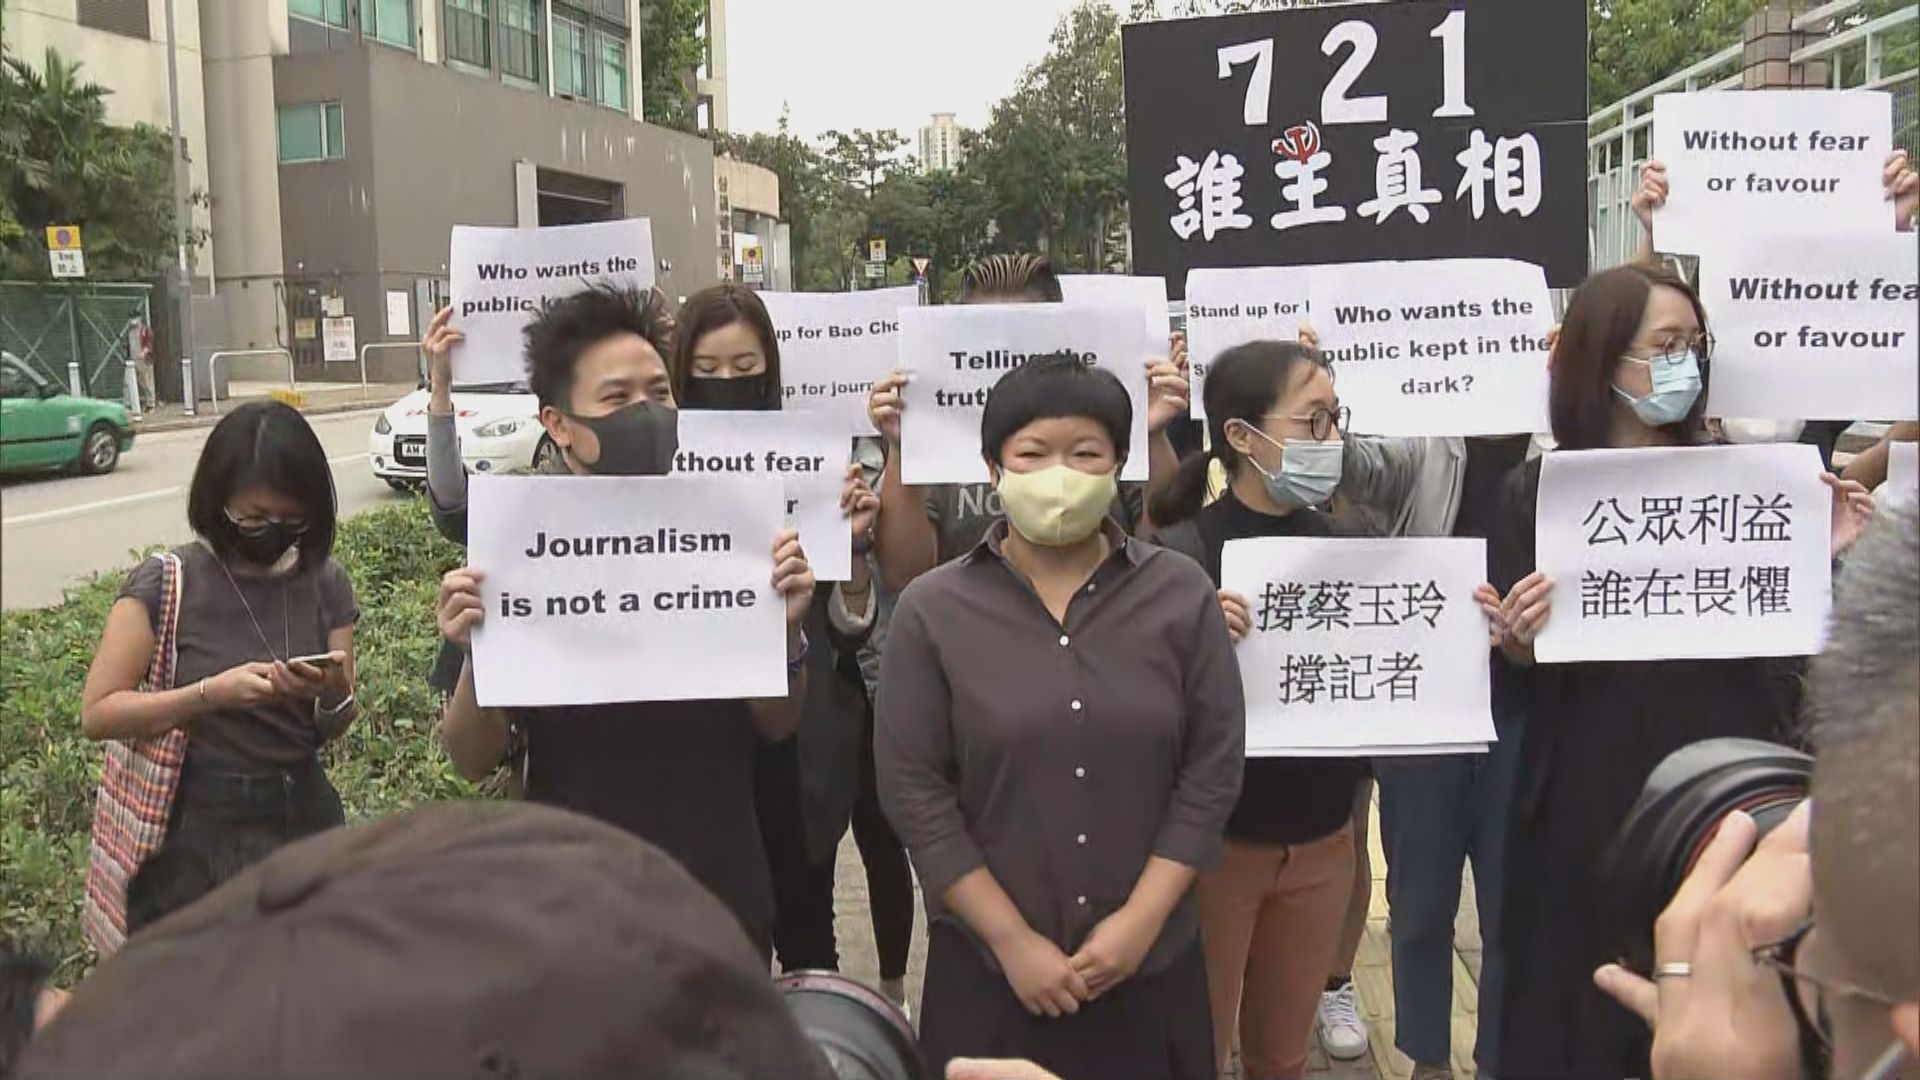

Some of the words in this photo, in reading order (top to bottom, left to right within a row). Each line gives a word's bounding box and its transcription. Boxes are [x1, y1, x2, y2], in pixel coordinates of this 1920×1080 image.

[1683, 129, 1798, 151] Without
[1808, 130, 1869, 151] fear
[1707, 177, 1736, 192] or
[1746, 173, 1840, 192] favour
[477, 263, 528, 281] Who
[536, 258, 601, 279] wants
[606, 255, 637, 274] the
[1729, 278, 1859, 300] Without
[1870, 278, 1918, 301] fea
[462, 295, 534, 317] public
[1189, 304, 1240, 319] Stand
[1246, 305, 1268, 320] up
[1274, 302, 1300, 315] for
[1335, 306, 1392, 325] Who
[1401, 299, 1482, 320] wants
[1492, 297, 1533, 316] the
[797, 326, 822, 340] for
[828, 325, 863, 338] Bao
[1754, 330, 1788, 348] or
[1797, 325, 1906, 348] favour
[950, 349, 1040, 371] Tellin
[1323, 342, 1400, 365] public
[1409, 338, 1469, 361] kept
[1477, 335, 1501, 355] in
[1510, 333, 1551, 354] the
[801, 382, 826, 396] for
[1400, 374, 1474, 395] dark?
[673, 451, 755, 472] thout
[764, 451, 825, 472] fear
[1583, 493, 1792, 545] 公眾利益
[525, 528, 731, 558] Journalism
[500, 591, 532, 617] is
[546, 588, 606, 616] not
[619, 593, 640, 612] a
[653, 584, 756, 611] crime
[1581, 566, 1791, 618] 誰在畏懼
[1256, 580, 1446, 632] 撐蔡玉玲
[1279, 651, 1423, 704] 撐記者
